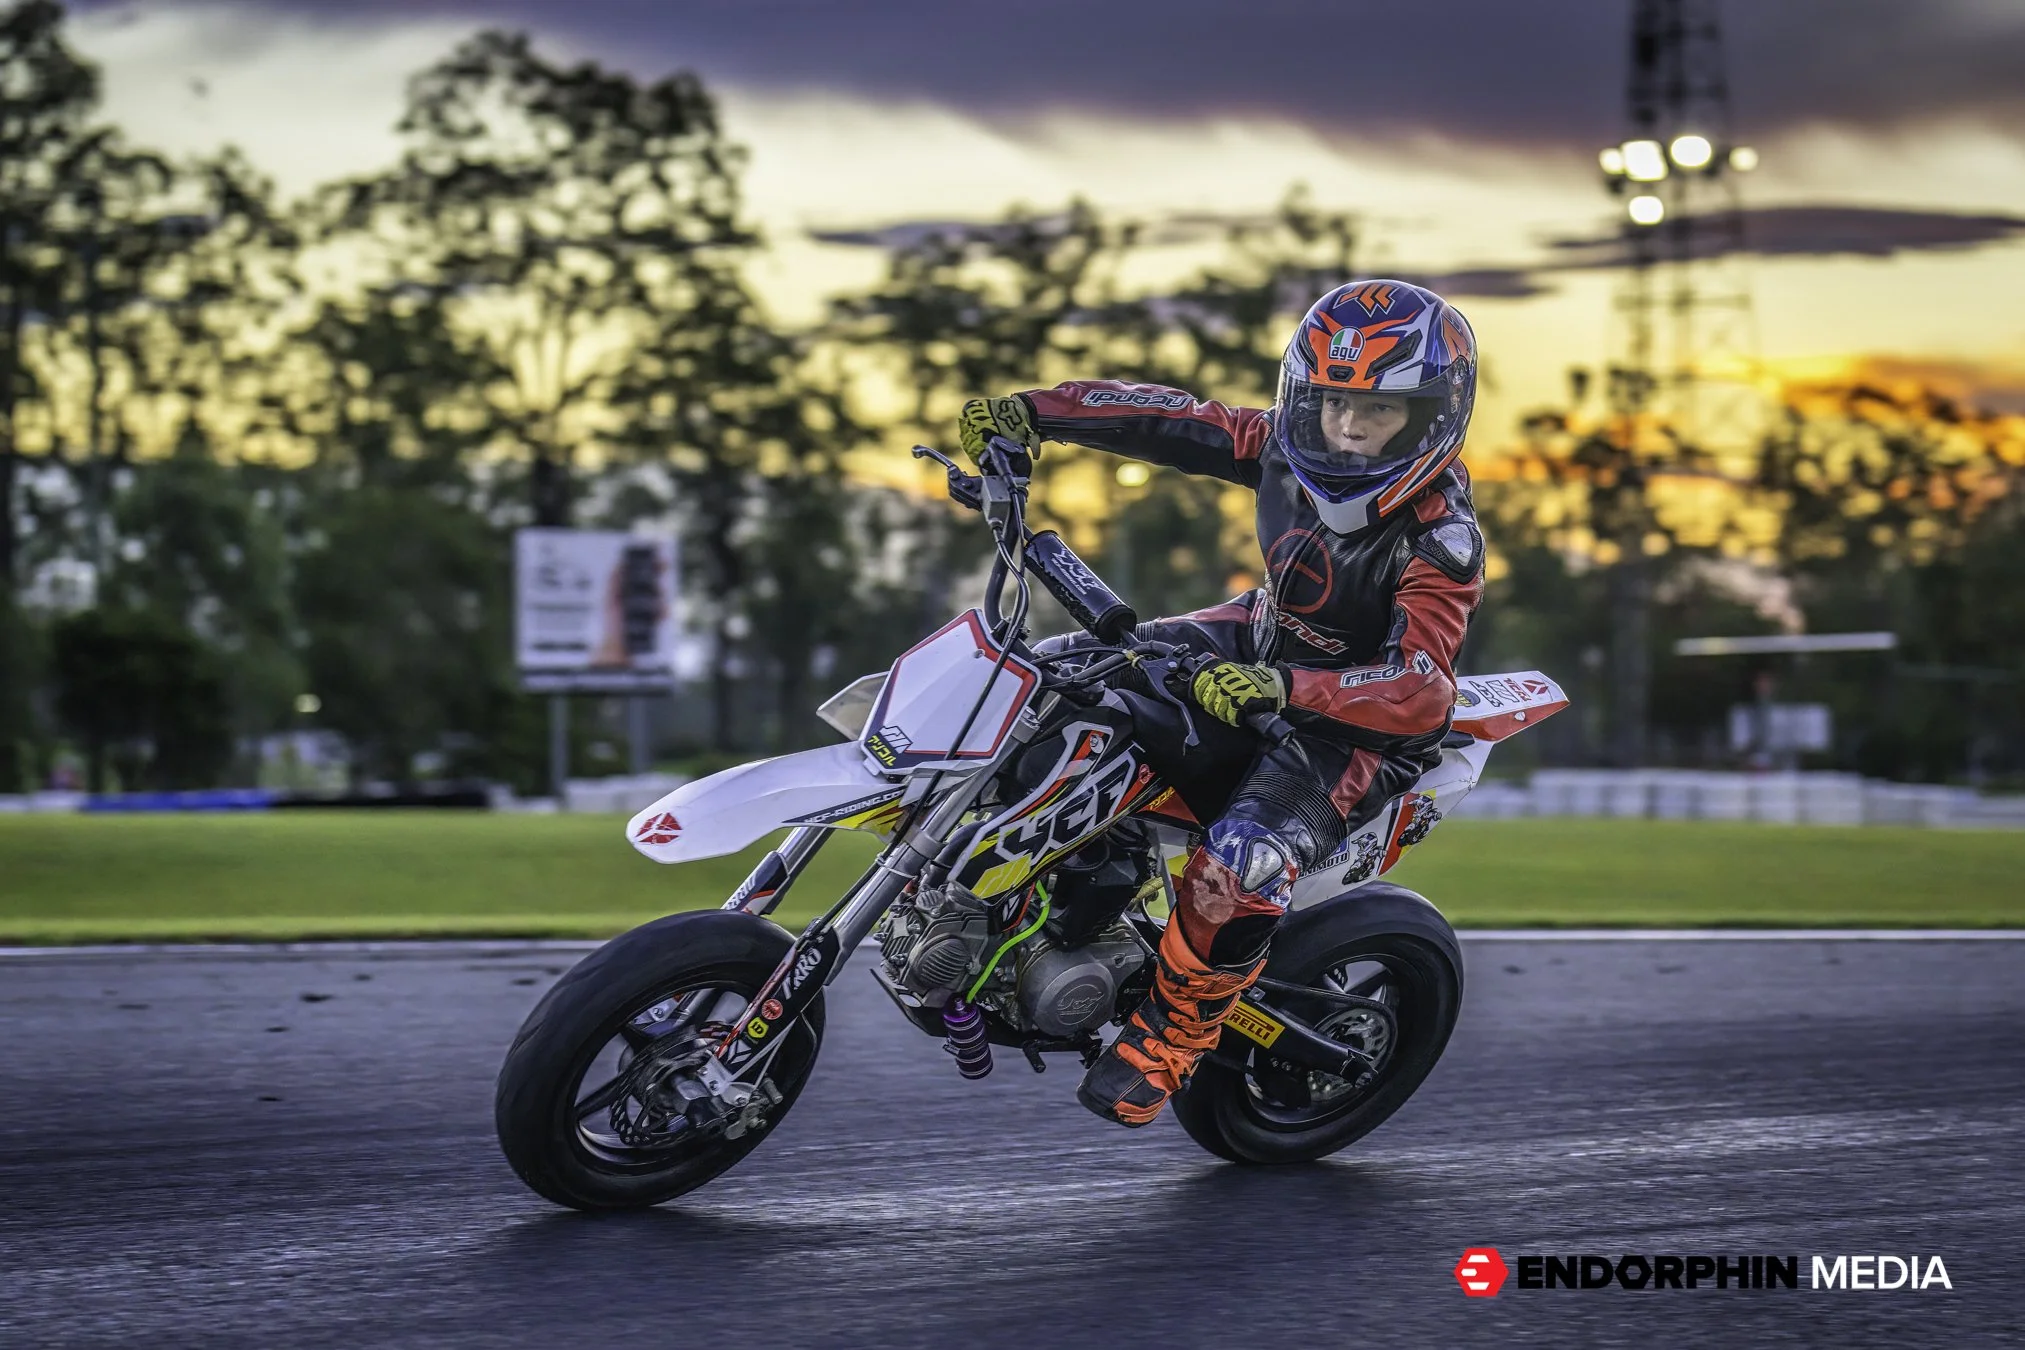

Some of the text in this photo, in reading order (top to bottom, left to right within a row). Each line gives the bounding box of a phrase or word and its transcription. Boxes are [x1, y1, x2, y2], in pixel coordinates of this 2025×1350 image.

[1213, 664, 1263, 706] FOX
[804, 788, 905, 823] YCF-RIDING.CO
[1229, 1006, 1275, 1041] RELLI
